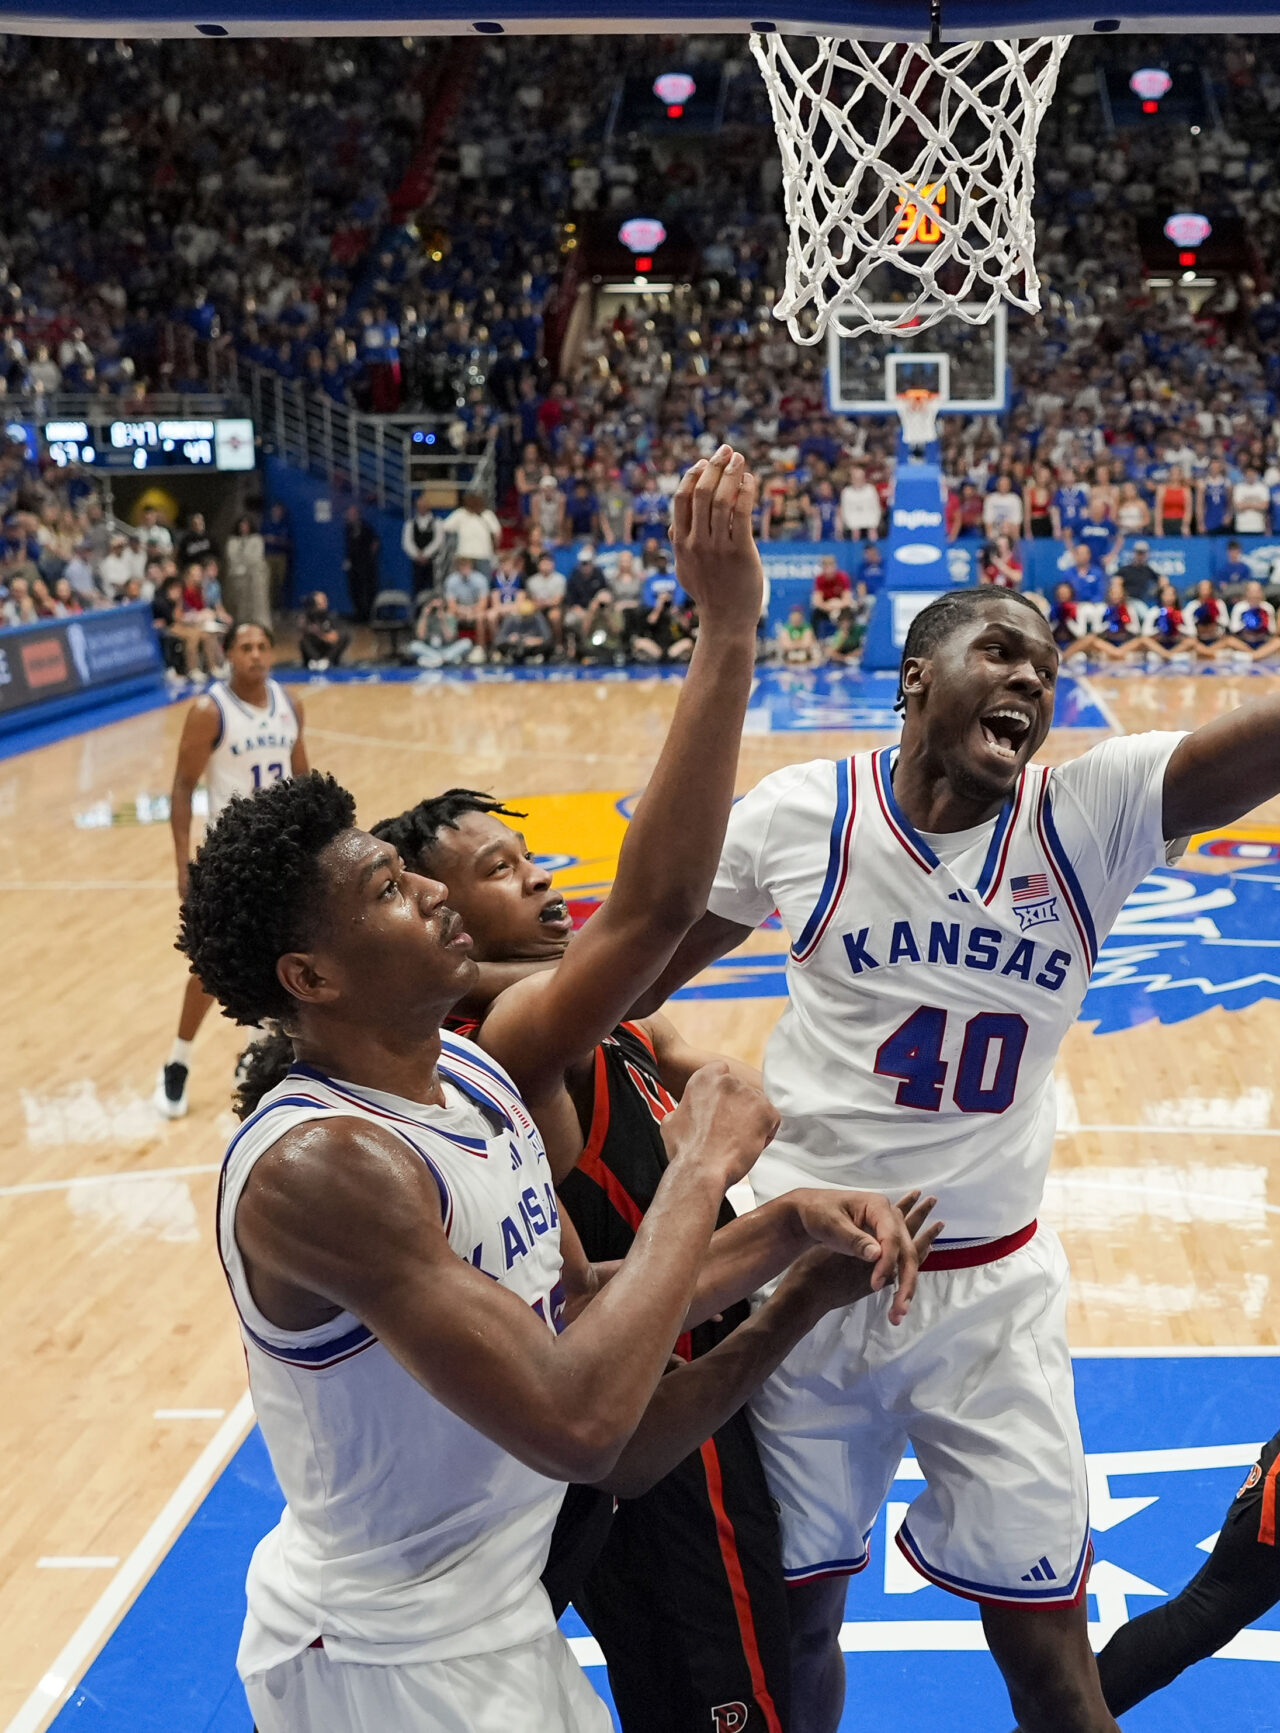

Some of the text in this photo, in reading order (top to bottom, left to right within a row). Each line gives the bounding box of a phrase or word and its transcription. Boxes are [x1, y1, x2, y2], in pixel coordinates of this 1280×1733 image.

[1018, 901, 1055, 928] XII
[842, 920, 1072, 991] KANSAS
[873, 1005, 1029, 1114] 40
[711, 1701, 748, 1733] P
